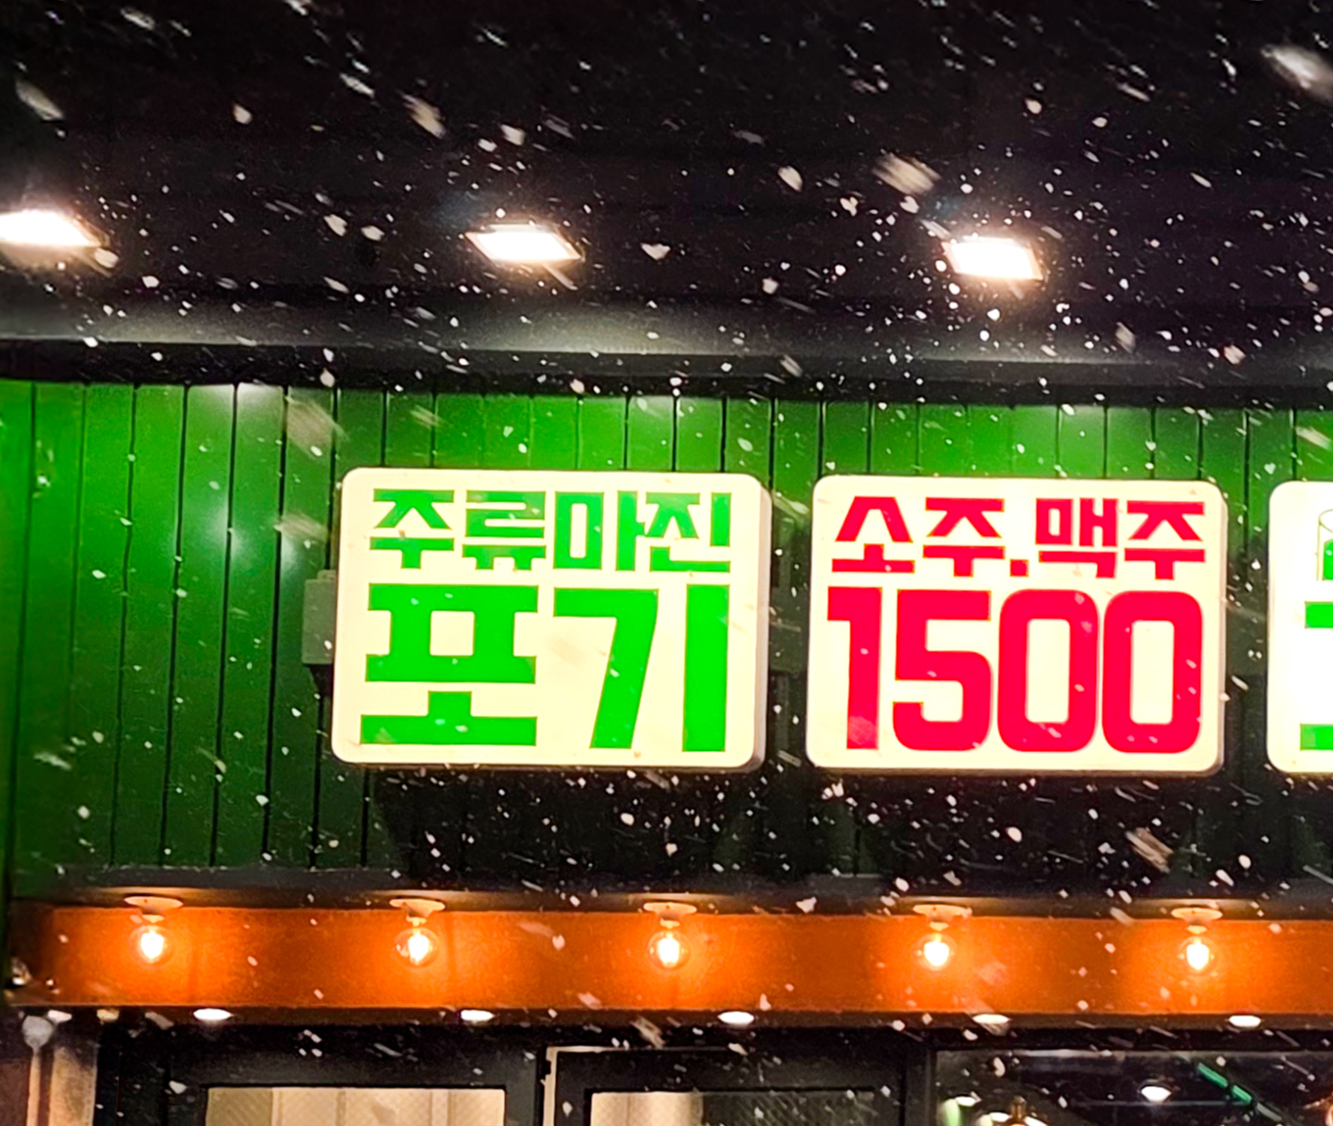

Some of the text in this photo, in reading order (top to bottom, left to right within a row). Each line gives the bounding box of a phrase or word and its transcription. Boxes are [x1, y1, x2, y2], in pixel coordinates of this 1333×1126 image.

[371, 488, 731, 574] 주류마진
[360, 583, 731, 752] 포기
[827, 585, 1203, 755] 1500
